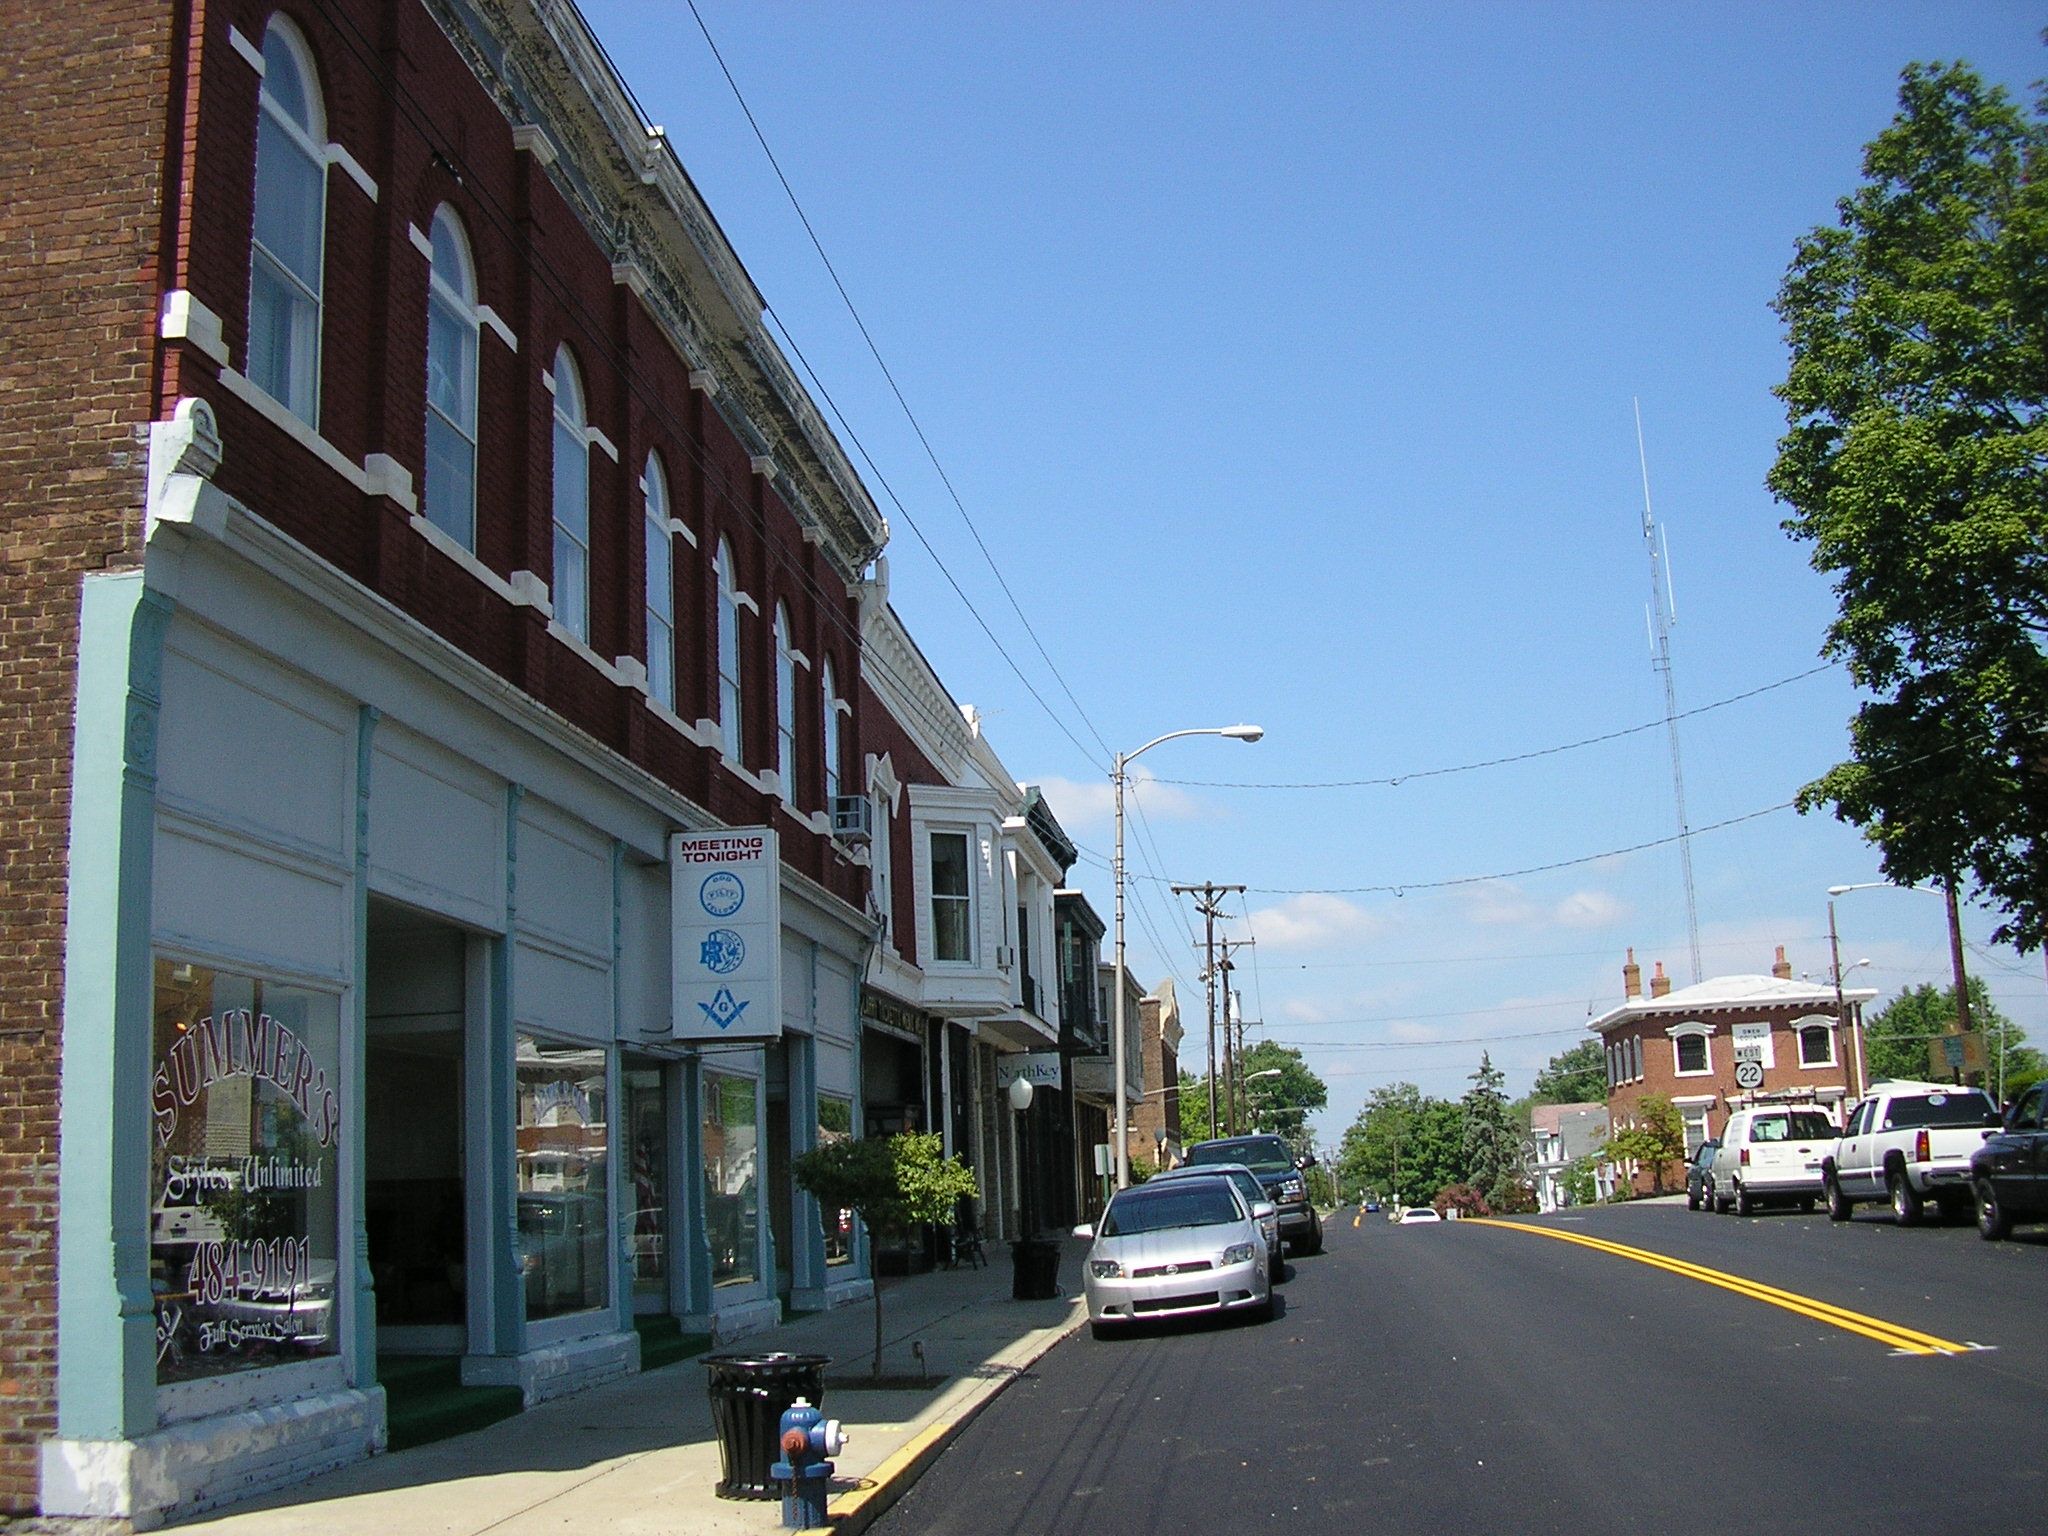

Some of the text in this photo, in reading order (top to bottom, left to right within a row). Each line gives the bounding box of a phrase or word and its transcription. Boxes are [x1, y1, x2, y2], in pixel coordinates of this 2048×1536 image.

[681, 837, 763, 851] MEETING
[682, 850, 763, 863] TONIGHT
[718, 1002, 729, 1012] G
[1736, 1048, 1759, 1058] WEST
[152, 1008, 334, 1149] SUMMER'S
[1740, 1067, 1759, 1082] 22
[239, 1156, 323, 1193] Unlimited
[187, 1235, 314, 1306] 484-9191
[200, 1319, 226, 1352] Full
[228, 1316, 271, 1348] Service
